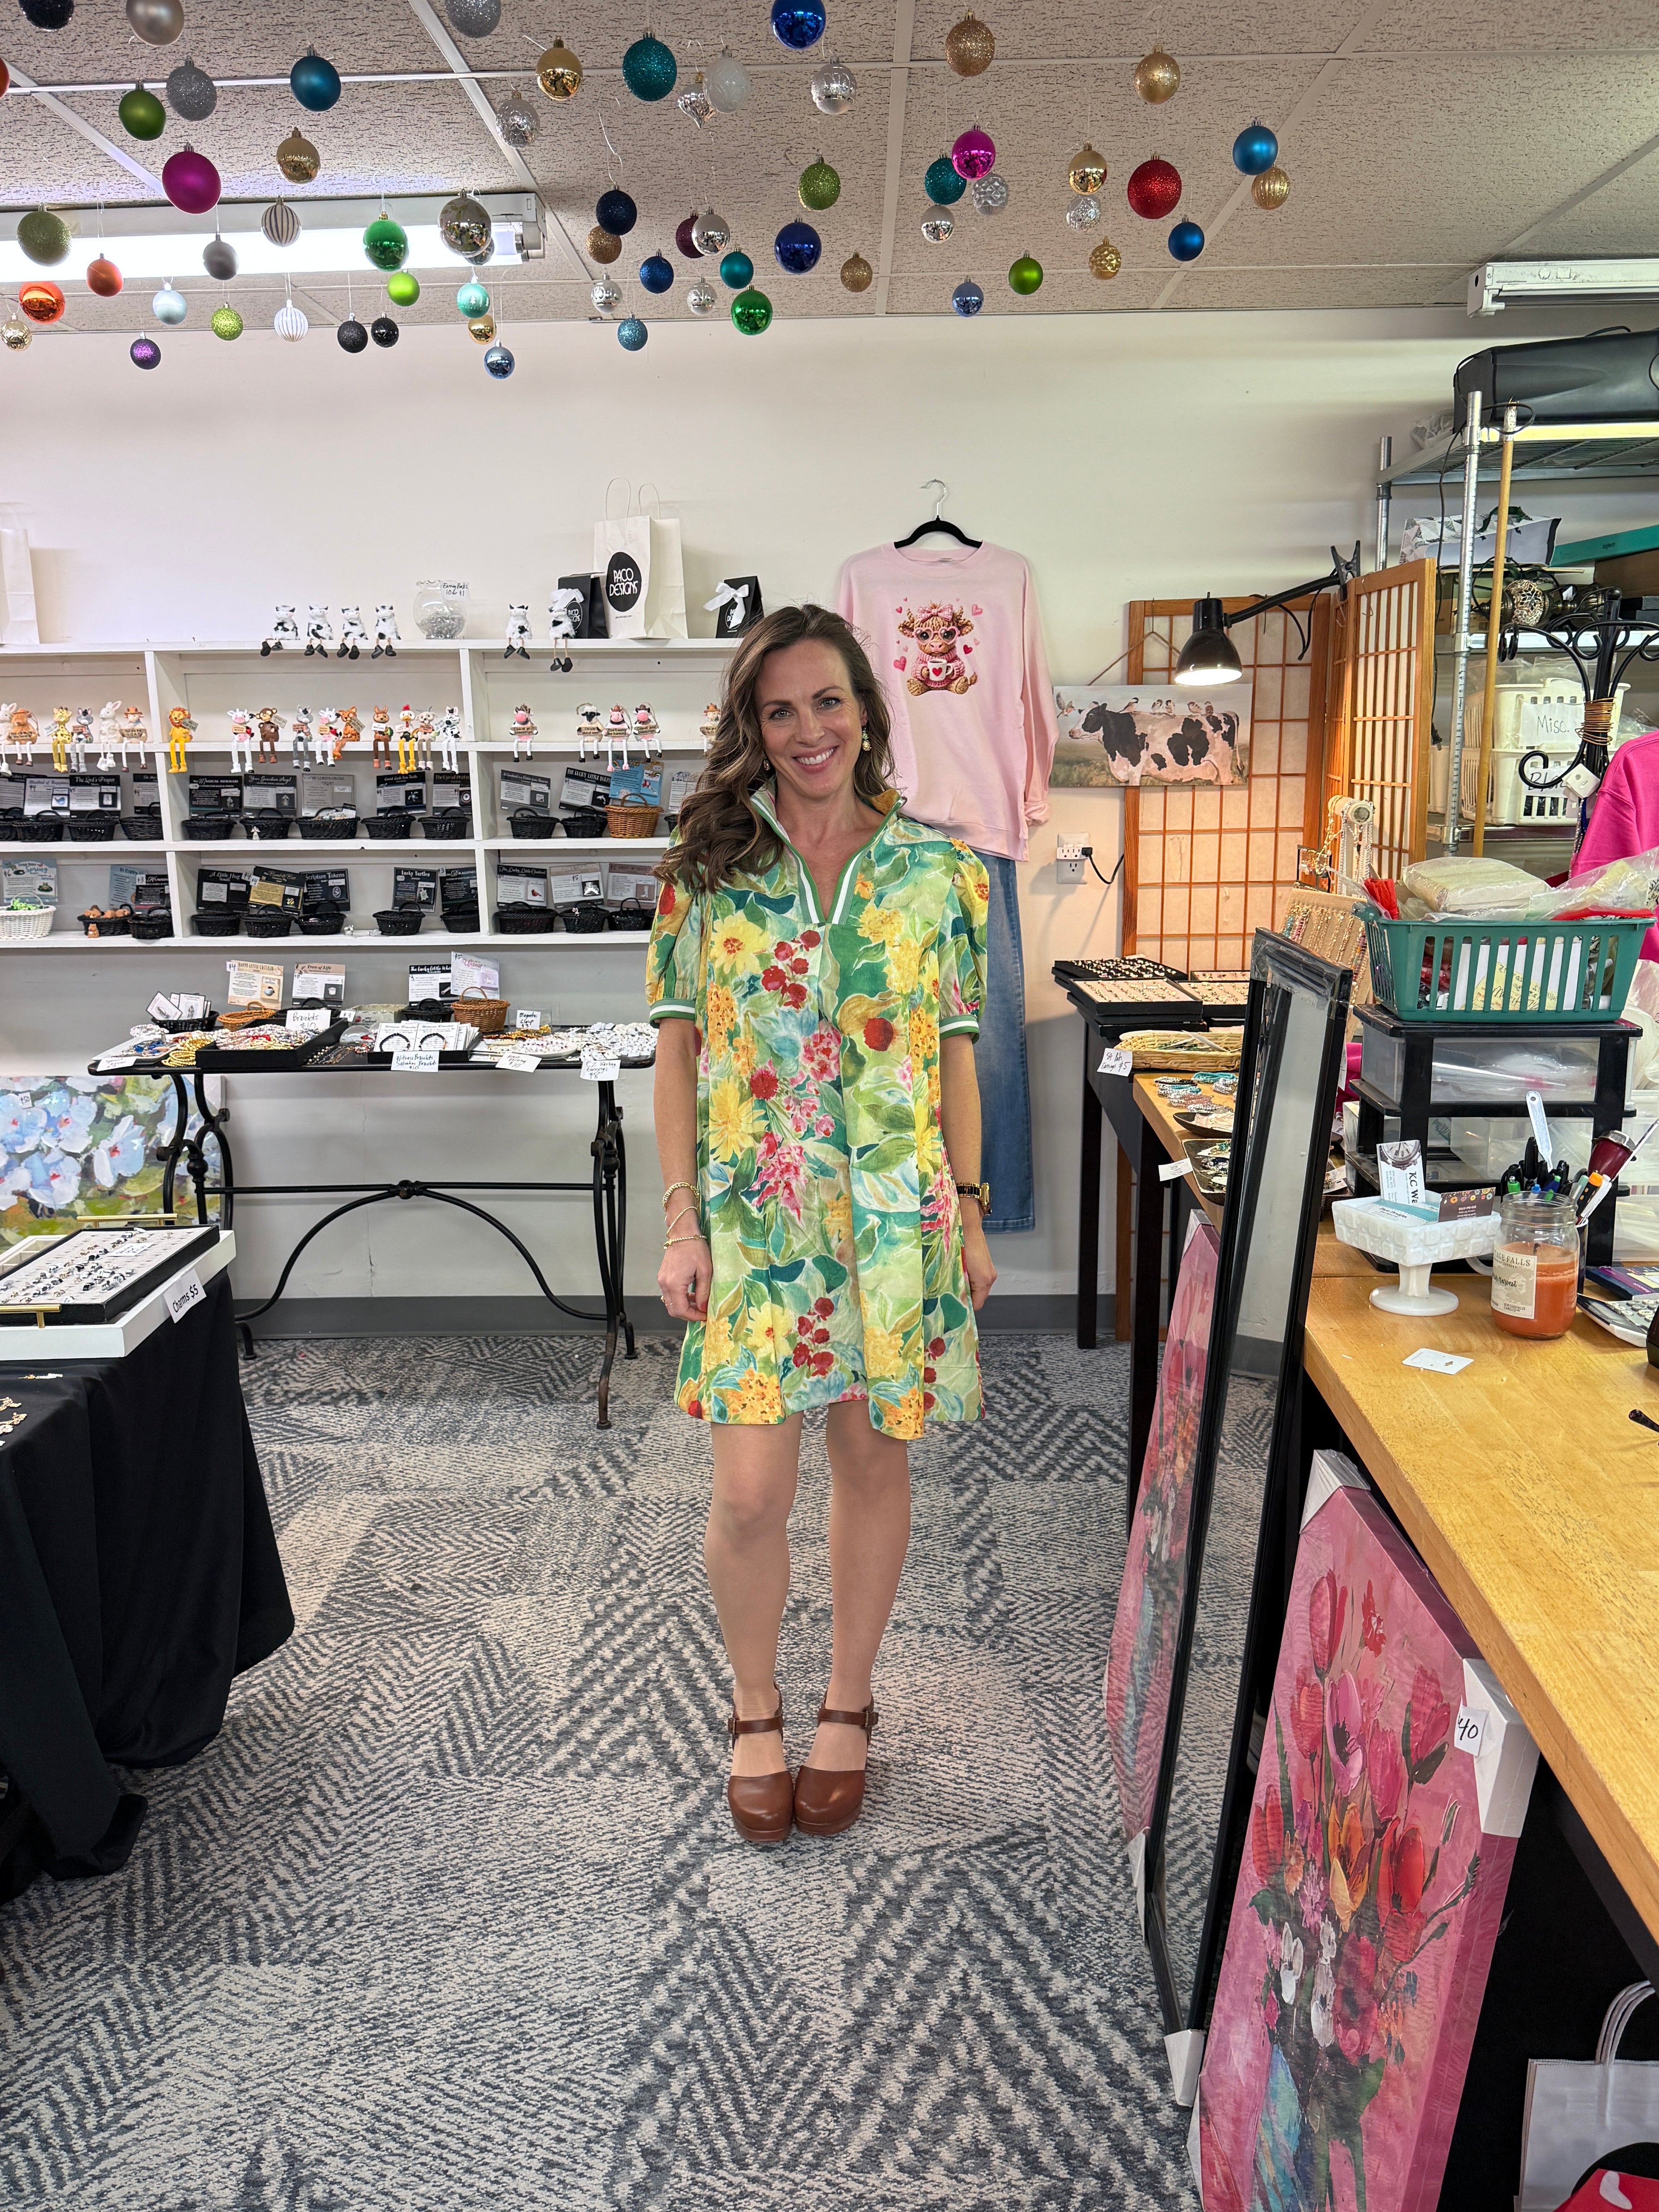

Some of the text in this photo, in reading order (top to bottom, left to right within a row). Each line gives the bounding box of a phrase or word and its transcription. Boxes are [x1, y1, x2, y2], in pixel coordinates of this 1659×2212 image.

[613, 568, 634, 583] PACO
[609, 581, 639, 597] DESIGNS
[1537, 715, 1570, 735] Misc.
[575, 770, 587, 778] LUCKY
[229, 963, 236, 971] $4
[1119, 1061, 1131, 1072] $5
[1409, 1171, 1417, 1187] KC
[1494, 1250, 1531, 1267] TAGE FALLS
[1498, 1276, 1518, 1287] Harvest
[172, 1284, 199, 1313] Charms $5
